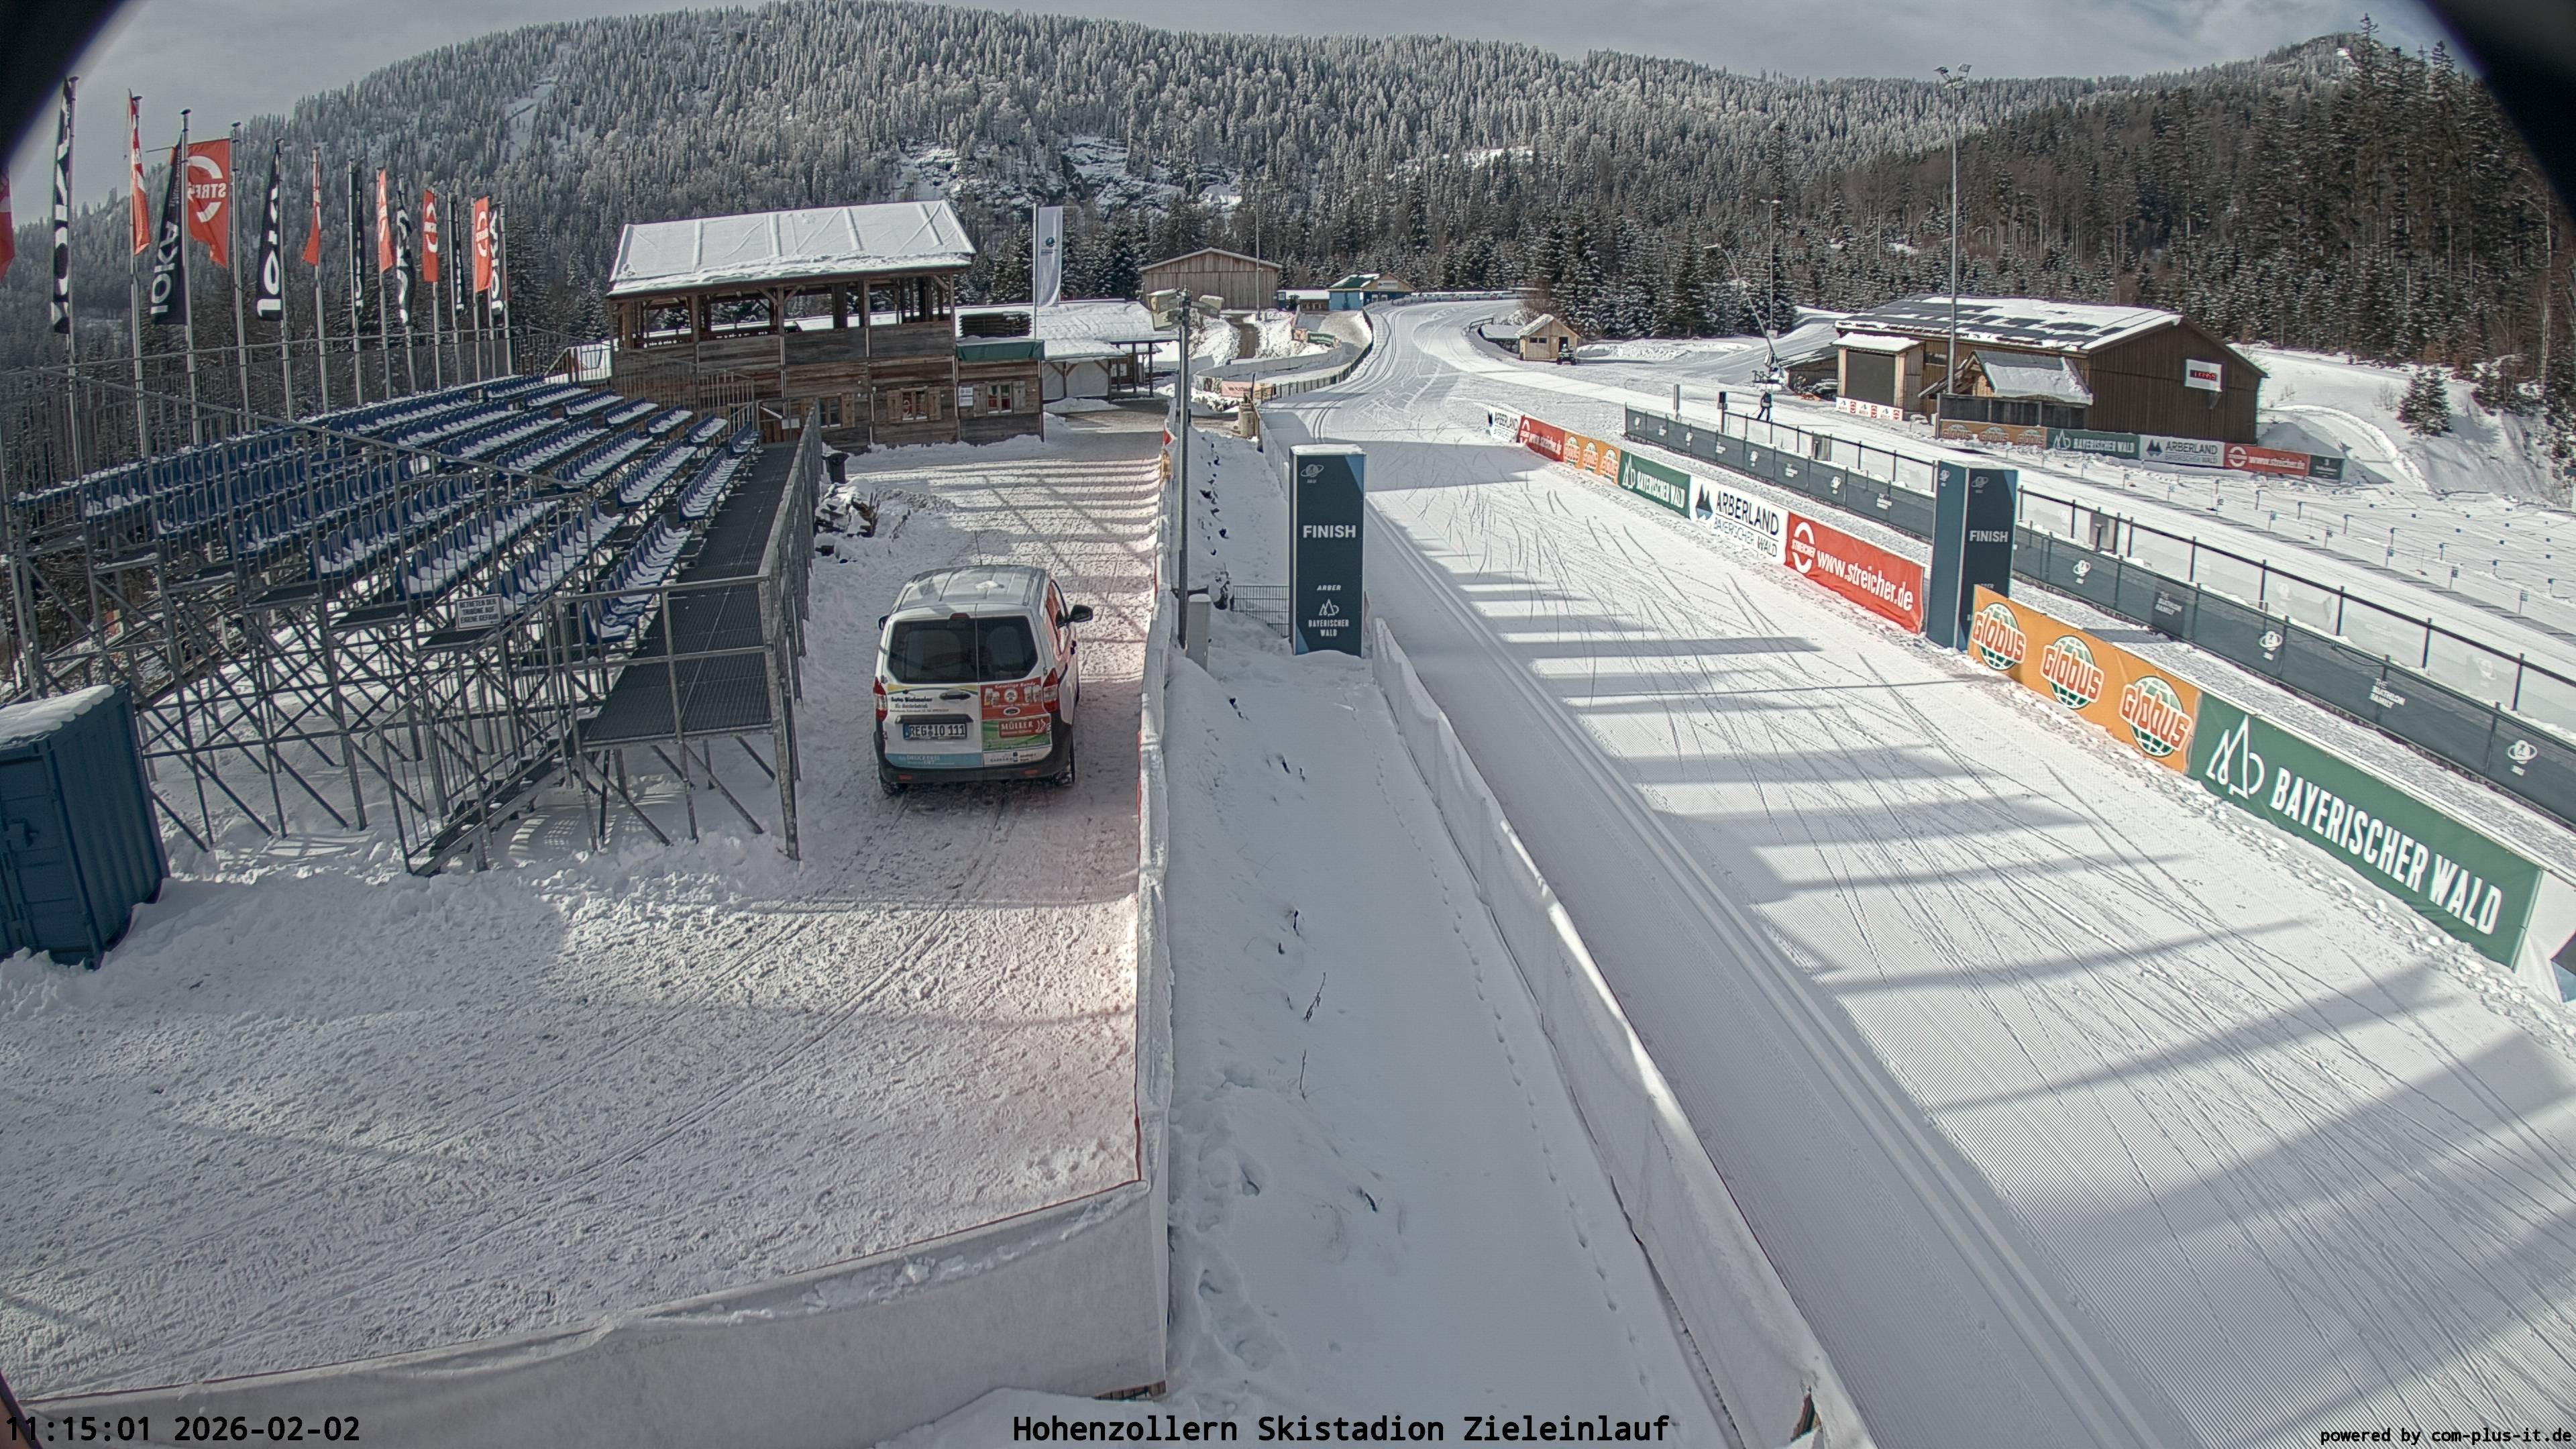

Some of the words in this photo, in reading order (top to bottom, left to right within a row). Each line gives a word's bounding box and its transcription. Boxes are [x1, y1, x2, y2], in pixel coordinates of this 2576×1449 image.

[2073, 437, 2116, 453] BAYERISCHER
[2117, 440, 2135, 453] WALD
[2165, 441, 2218, 455] ARBERLAND
[1636, 471, 1670, 502] BAYERISCHER
[1670, 484, 1685, 508] WALD
[1715, 490, 1779, 535] ARBERLAND
[1303, 525, 1356, 538] FINISH
[1713, 516, 1755, 547] BAYERISCHER
[1758, 535, 1778, 557] WALD
[1969, 530, 2008, 543] FINISH
[1817, 549, 1913, 611] www.streicher.de
[1308, 619, 1349, 627] BAYERISCHER
[1320, 629, 1337, 637] WALD
[2369, 692, 2395, 709] FAMILY
[2371, 685, 2406, 706] BIATHLON
[910, 726, 927, 737] REG
[948, 725, 966, 736] 111
[1001, 720, 1034, 731] MÜLLER
[2269, 766, 2429, 893] BAYERISCHER
[2428, 853, 2502, 936] WALD
